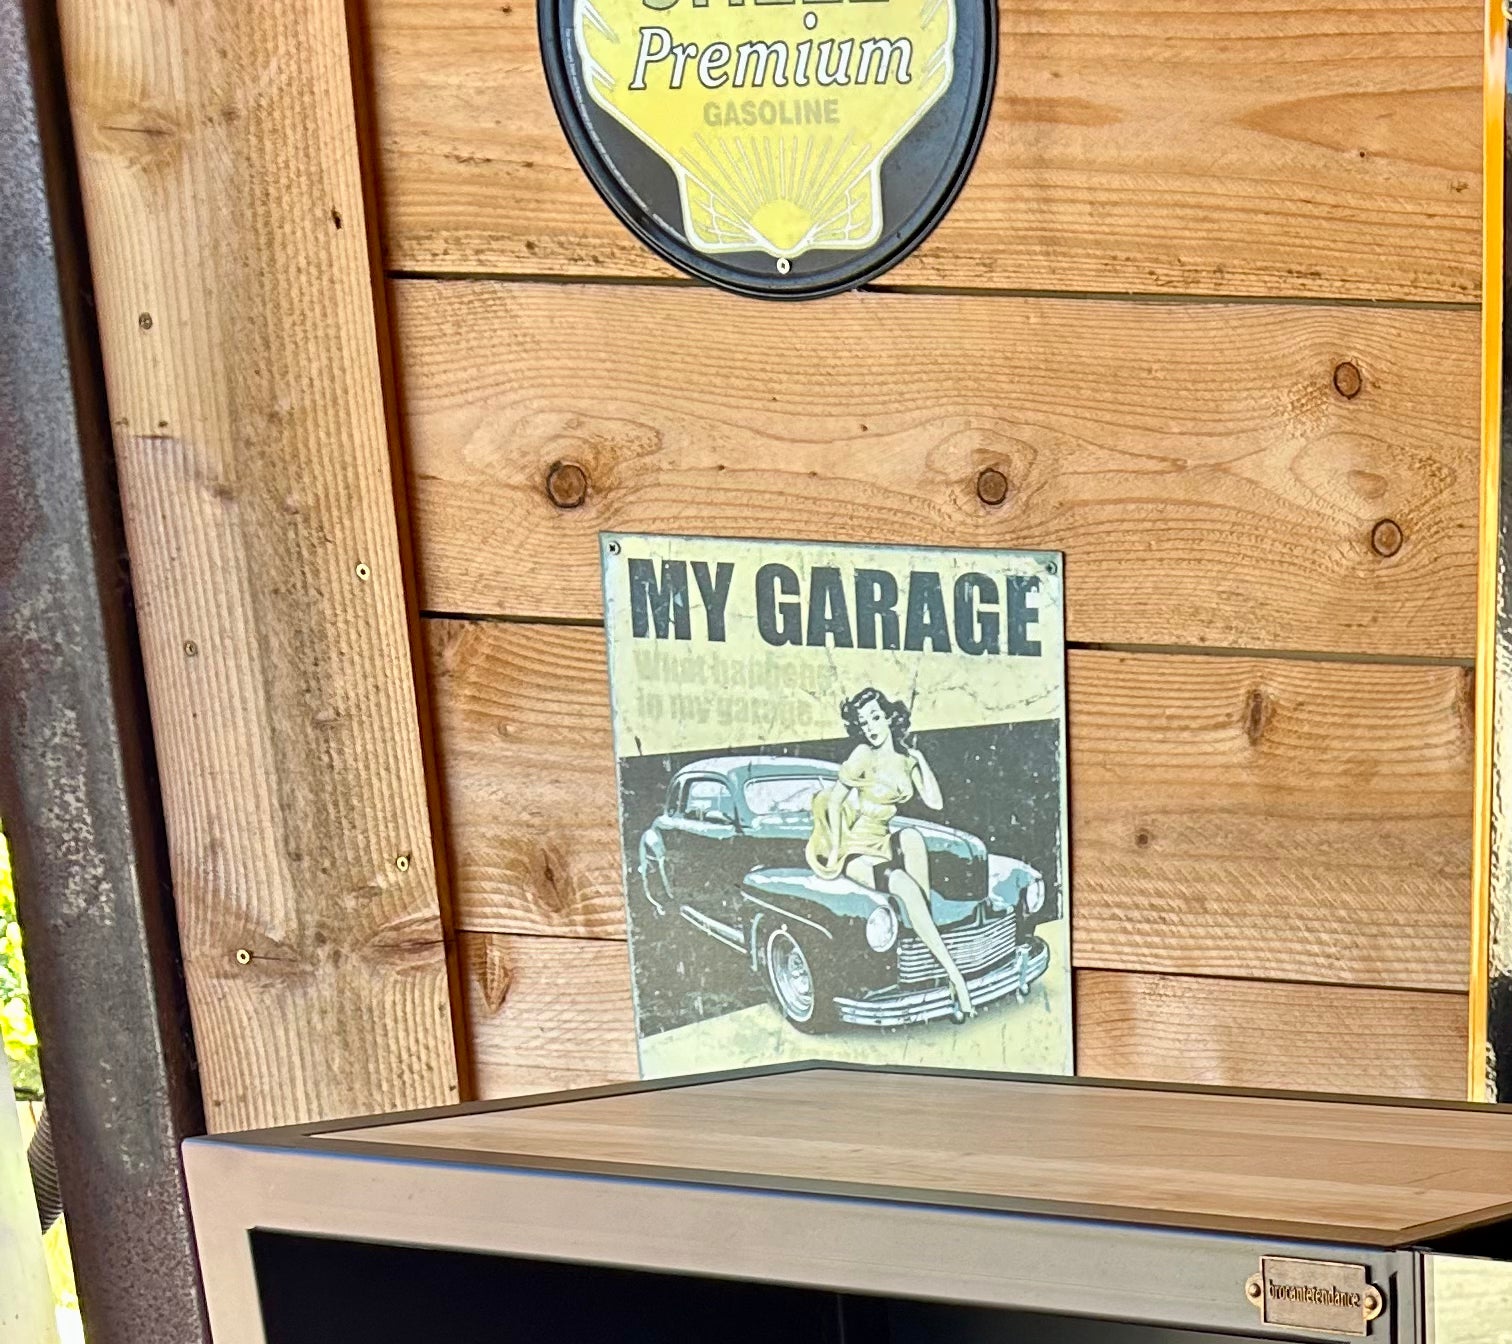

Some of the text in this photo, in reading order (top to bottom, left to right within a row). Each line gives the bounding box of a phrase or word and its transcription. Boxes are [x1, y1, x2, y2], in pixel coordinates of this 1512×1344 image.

[628, 11, 912, 90] Premium
[703, 98, 840, 127] GASOLINE
[627, 557, 1042, 657] MY GARAGE
